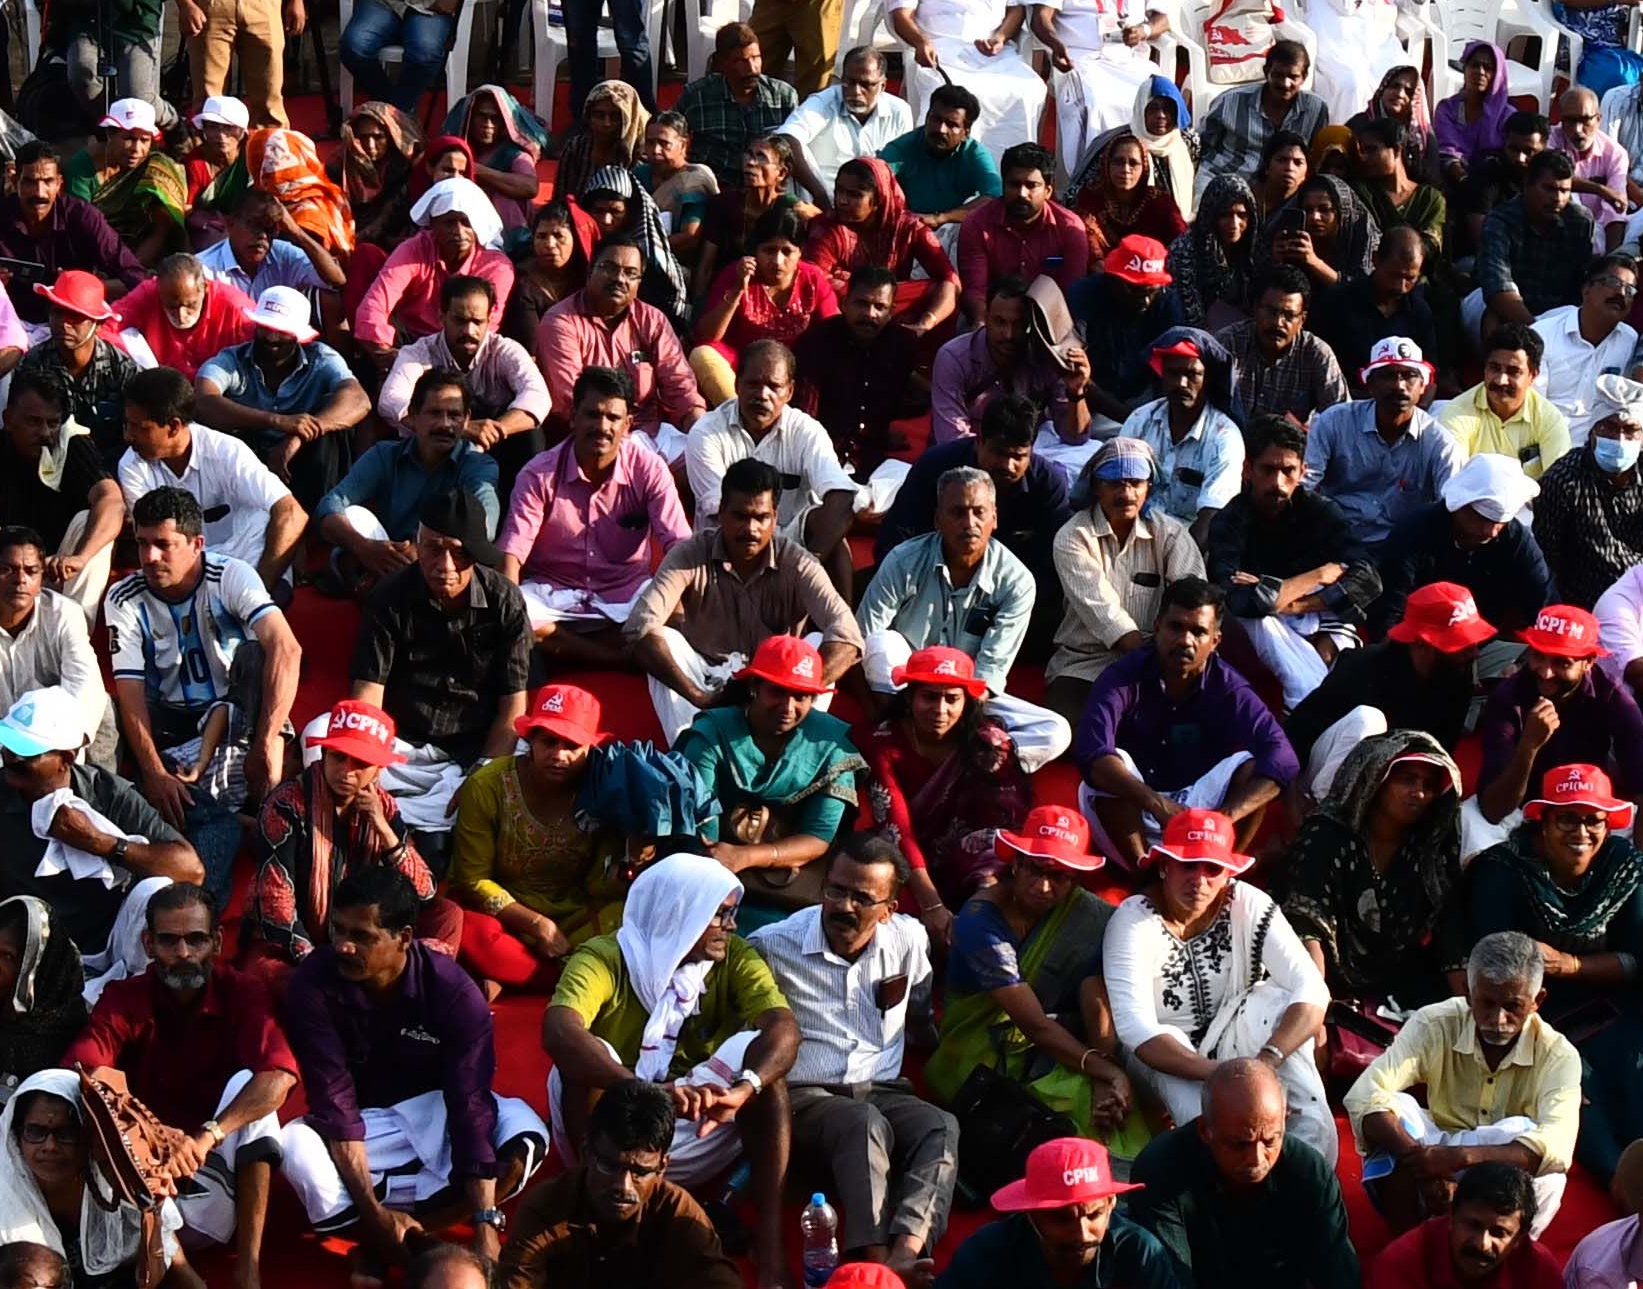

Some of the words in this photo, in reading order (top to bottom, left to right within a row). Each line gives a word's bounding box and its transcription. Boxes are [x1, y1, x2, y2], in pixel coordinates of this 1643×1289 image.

[1539, 614, 1585, 641] CPI-M
[1555, 781, 1593, 794] CPI(M)
[1039, 825, 1081, 846] CPI(M)
[1187, 829, 1228, 846] CPI(M)
